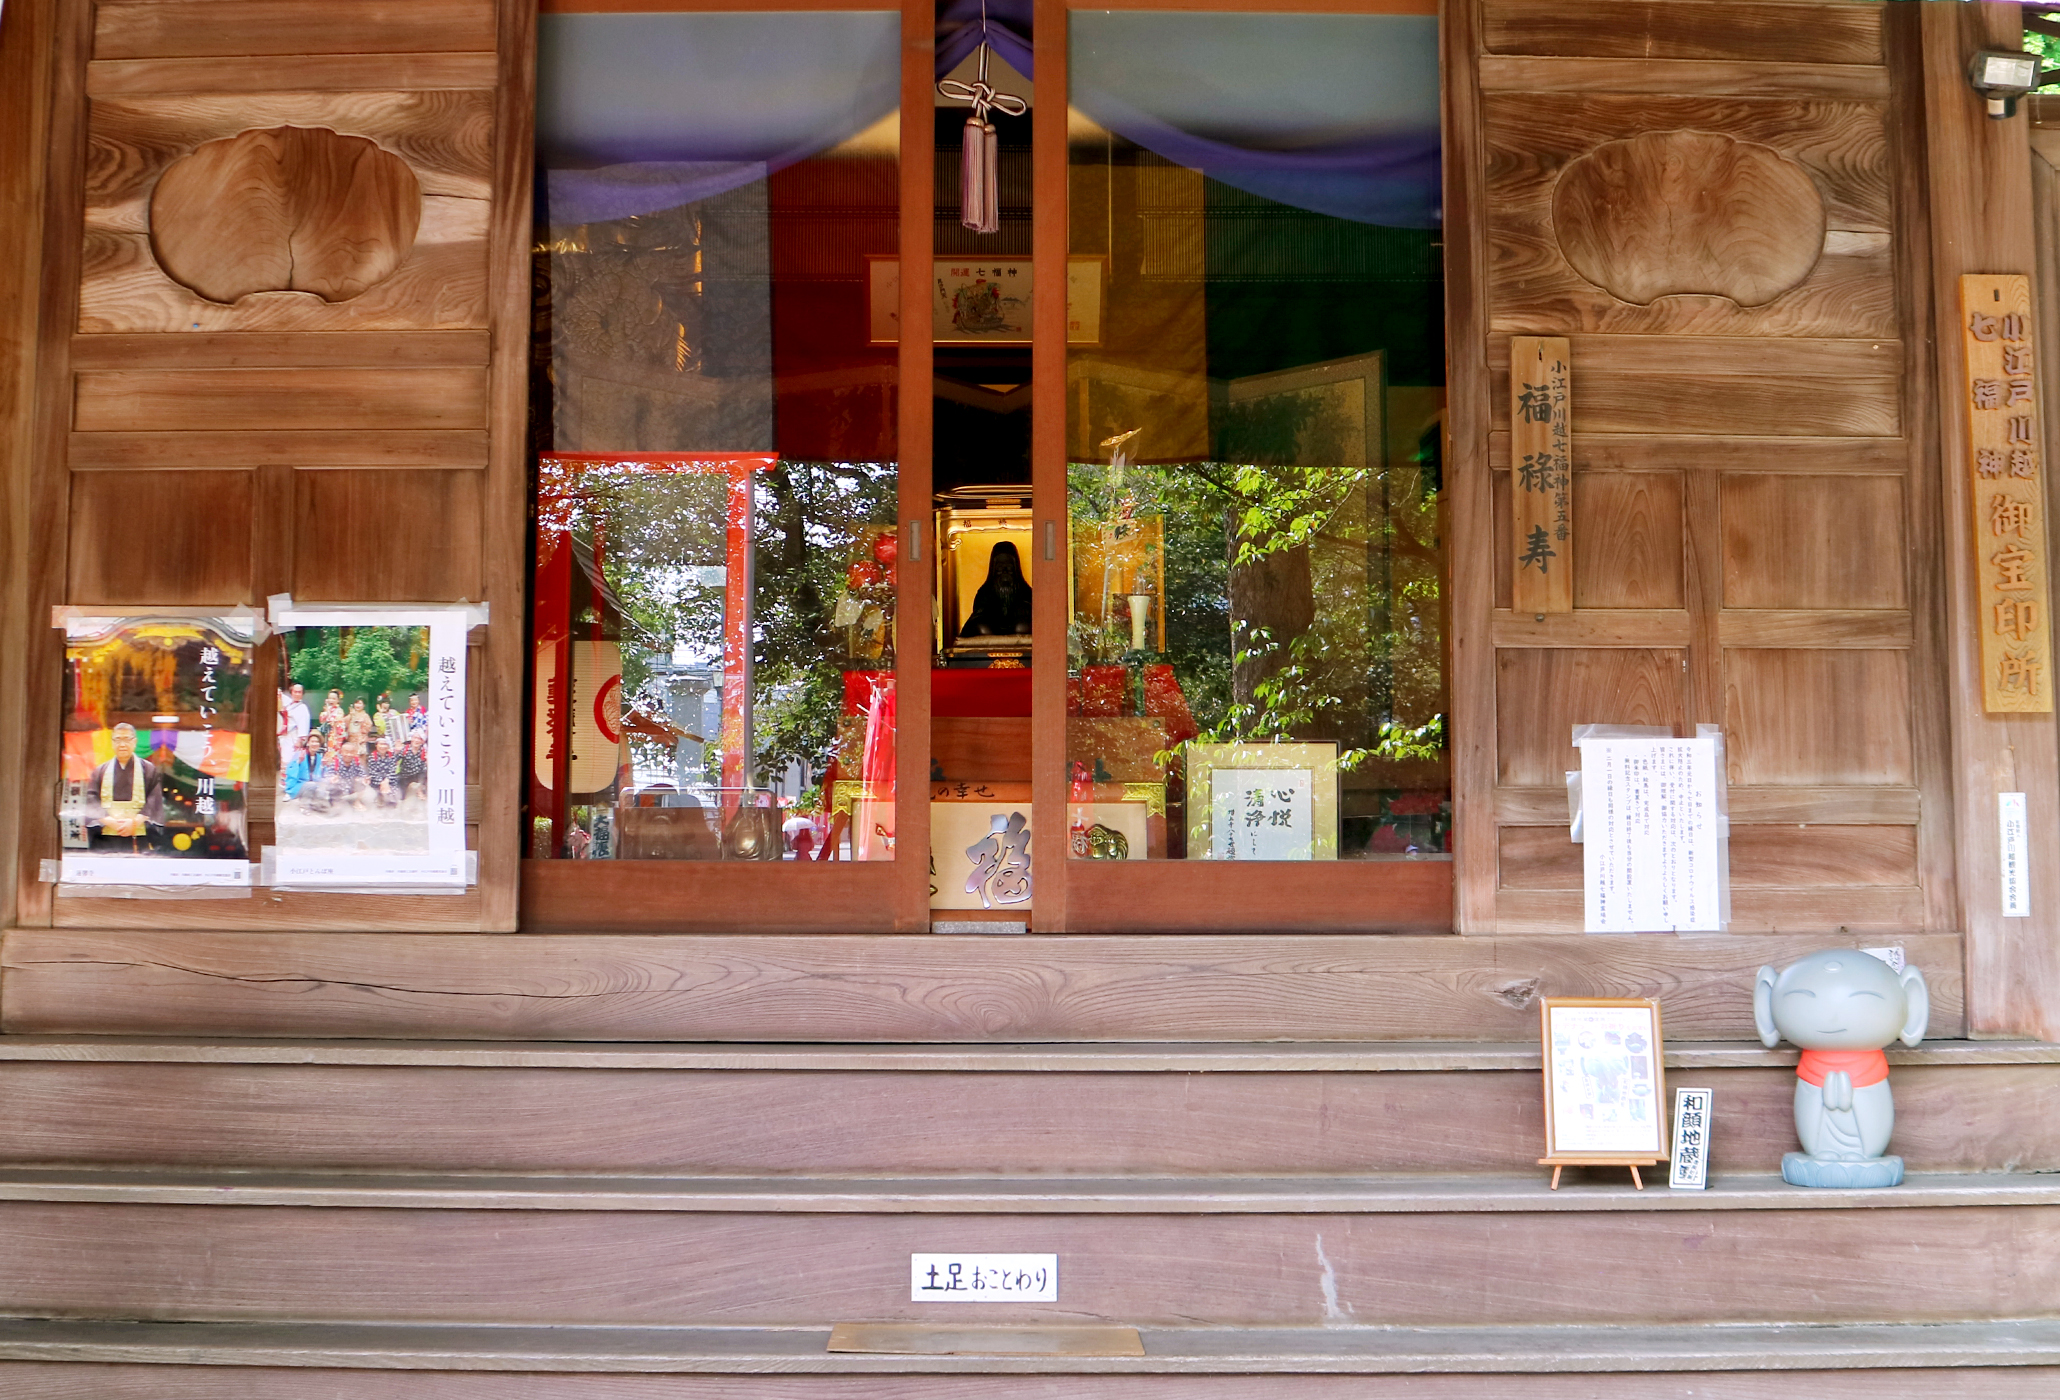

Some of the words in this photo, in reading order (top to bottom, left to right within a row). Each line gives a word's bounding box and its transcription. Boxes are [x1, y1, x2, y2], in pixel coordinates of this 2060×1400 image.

[949, 266, 1018, 278] 開運七福神
[1550, 359, 1570, 542] 小江戸川越七福神第五番
[1968, 312, 2003, 480] 七福神
[2001, 312, 2038, 480] 小江戸川越
[1991, 494, 2041, 696] 御宝印所
[195, 646, 219, 816] 越えていこう、川越
[436, 656, 457, 825] 越えていこう、川越
[1695, 790, 1703, 830] お知らせ
[965, 811, 1033, 910] 福
[921, 1262, 1048, 1292] 土足おことわり
